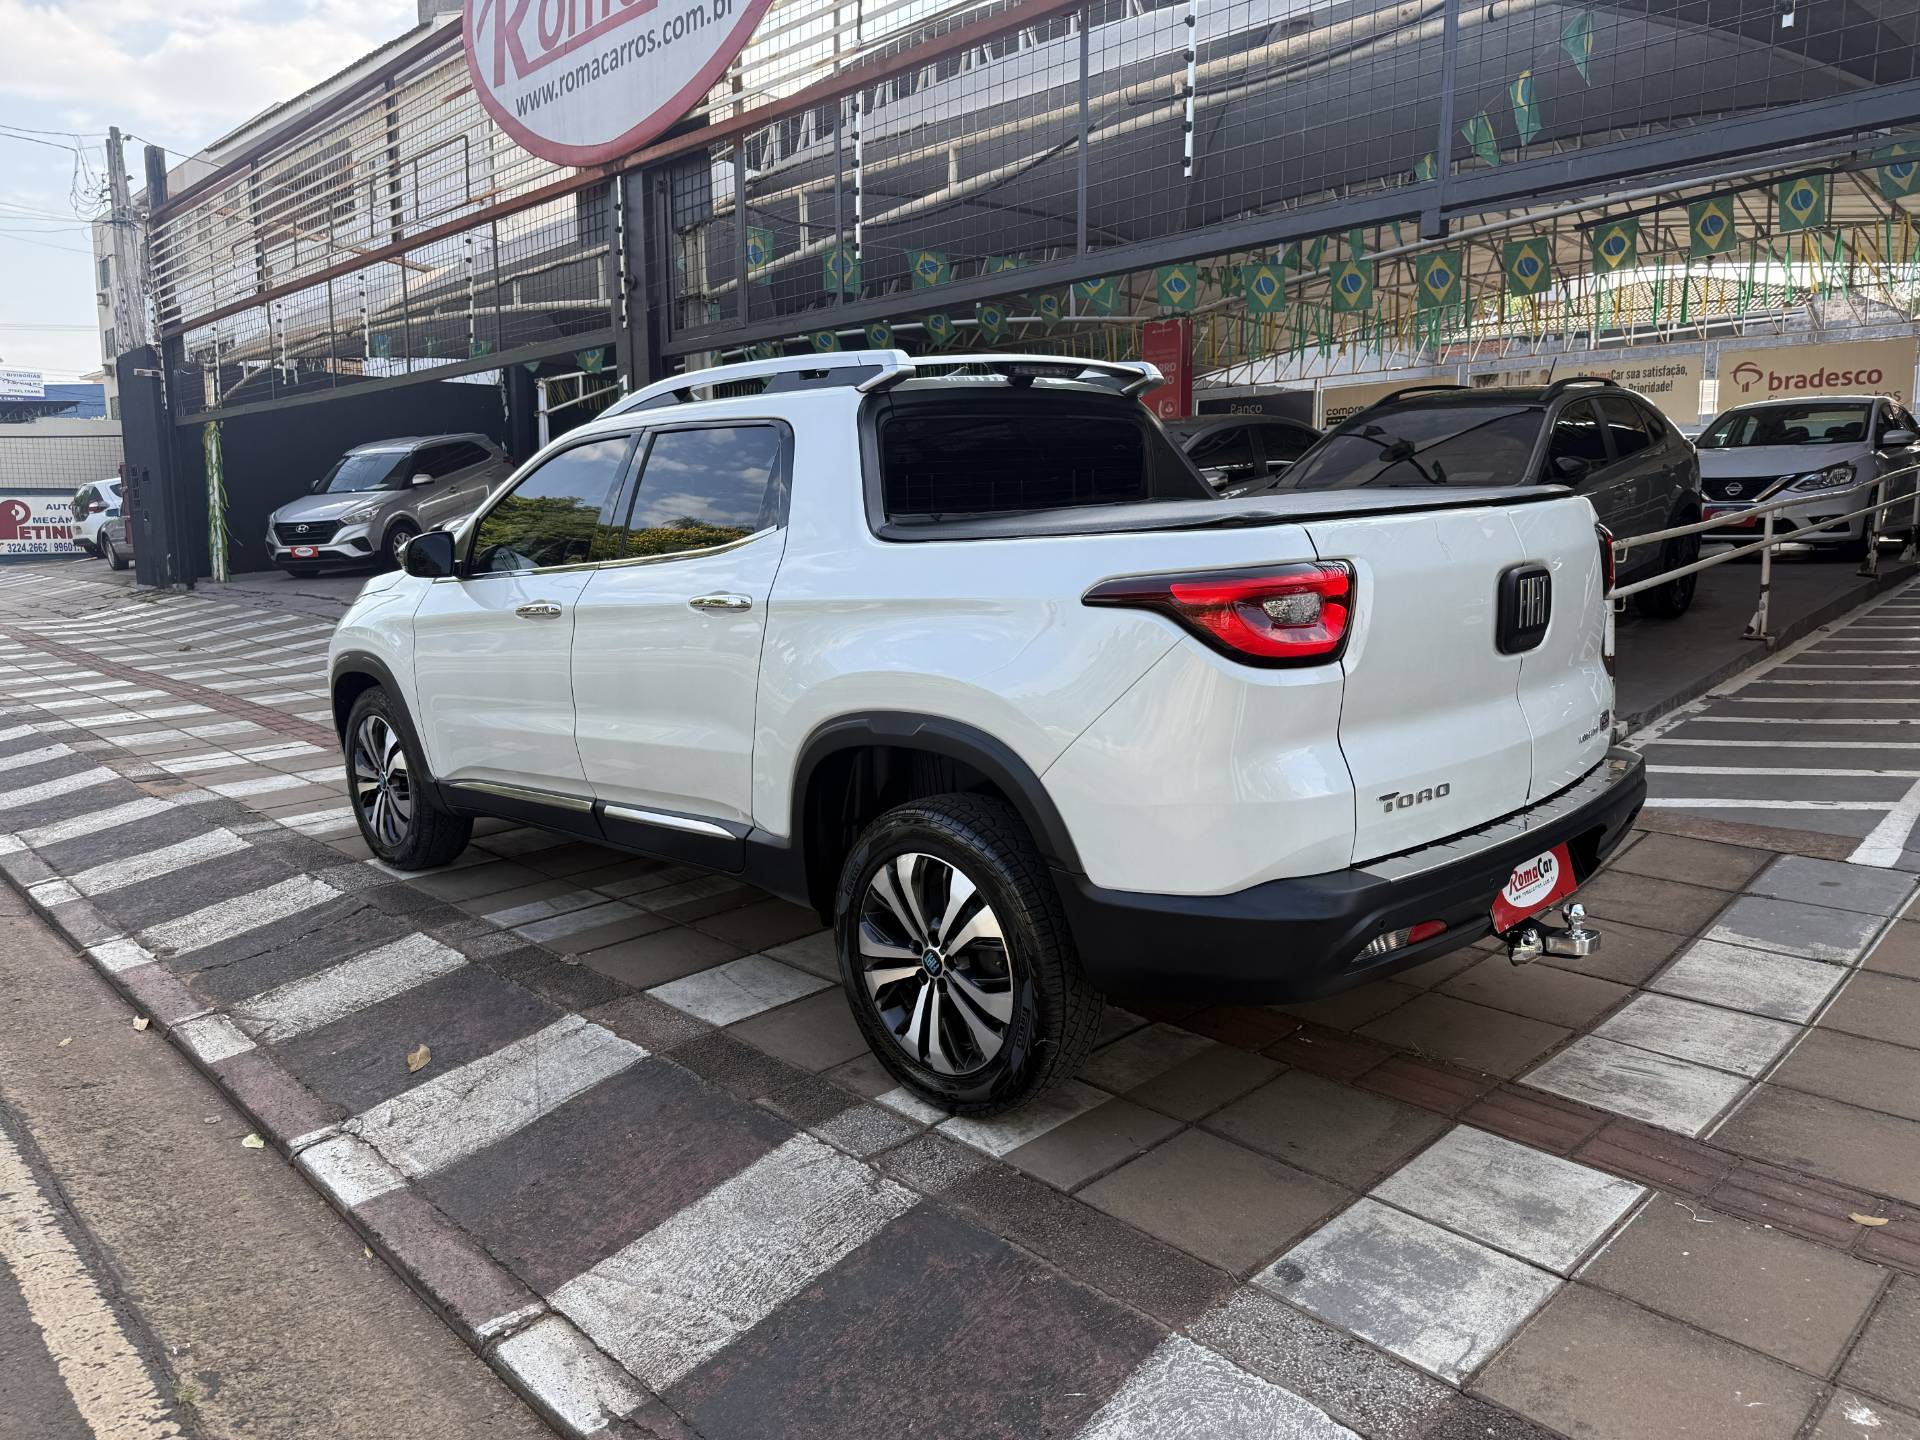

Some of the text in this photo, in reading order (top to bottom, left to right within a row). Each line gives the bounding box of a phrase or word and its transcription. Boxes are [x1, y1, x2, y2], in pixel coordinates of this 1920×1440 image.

[514, 0, 733, 118] www.romacarros.com.br
[1626, 369, 1641, 380] sua
[1642, 364, 1688, 379] satisfação,
[1768, 367, 1883, 391] bradesco
[7, 542, 48, 553] 3224.2662
[1376, 782, 1451, 813] TORO
[1508, 856, 1553, 897] RomaCar
